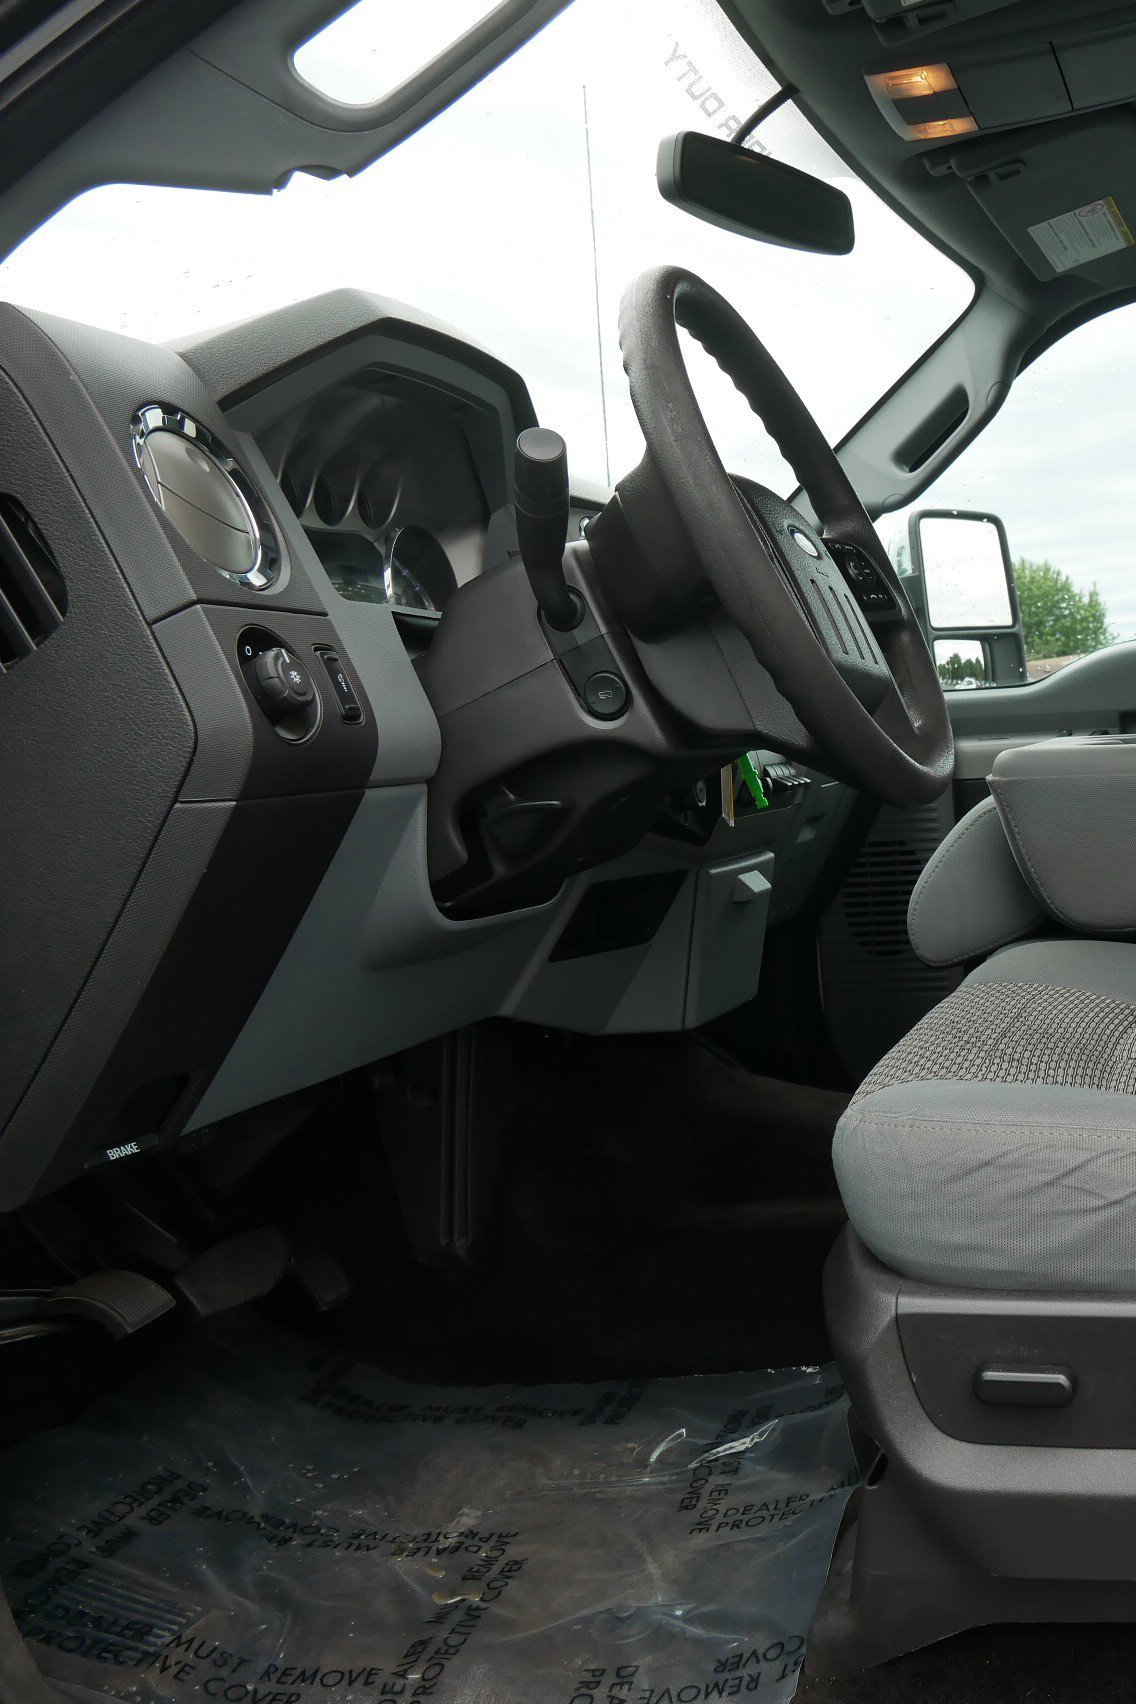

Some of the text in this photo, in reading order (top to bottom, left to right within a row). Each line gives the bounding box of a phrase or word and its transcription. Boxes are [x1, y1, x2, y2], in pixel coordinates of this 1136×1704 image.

[106, 1141, 141, 1161] BRAKE
[165, 1632, 255, 1674] MUST
[257, 1661, 384, 1688] REMOVE
[713, 1635, 805, 1673] COVER
[202, 1676, 302, 1704] COVER
